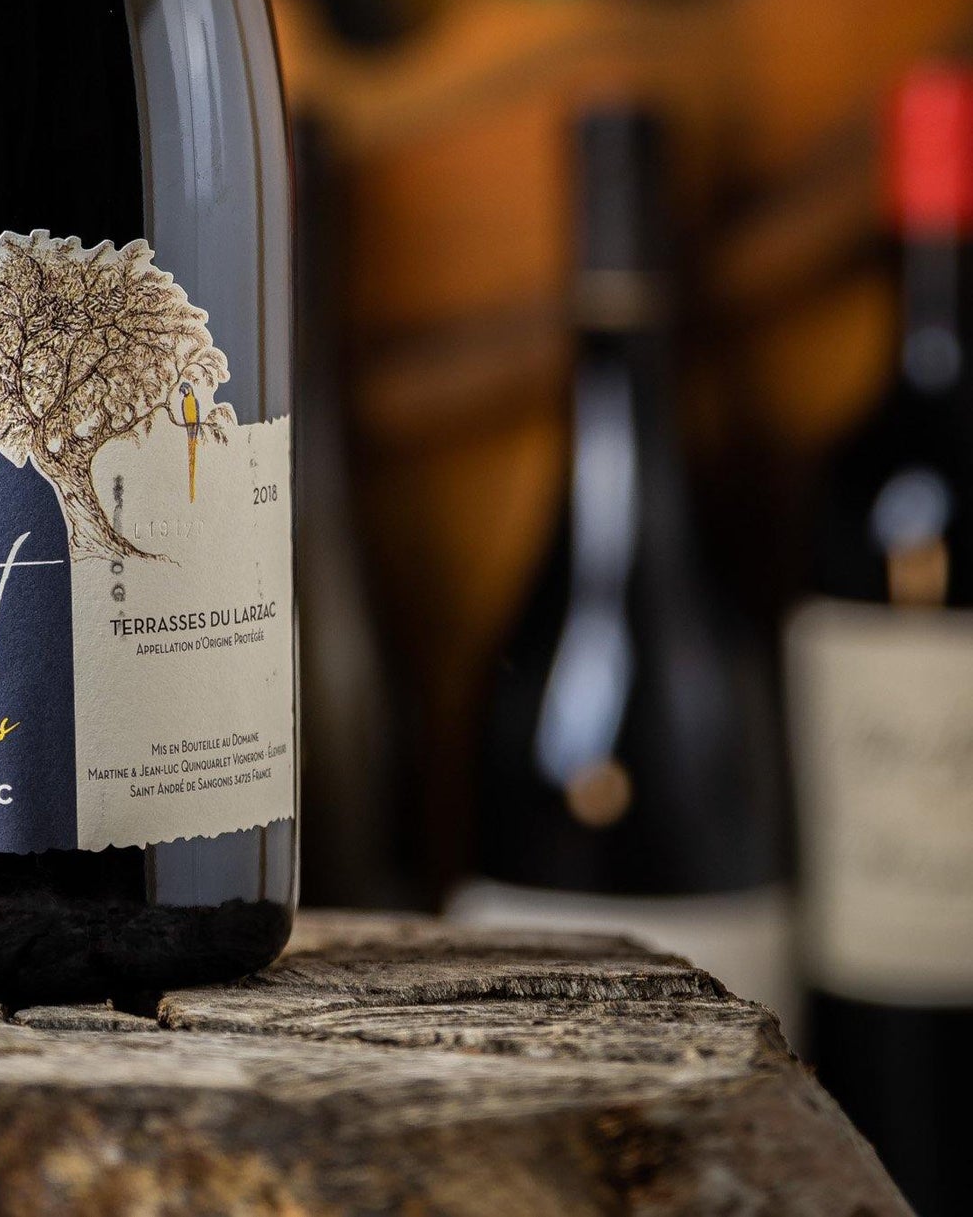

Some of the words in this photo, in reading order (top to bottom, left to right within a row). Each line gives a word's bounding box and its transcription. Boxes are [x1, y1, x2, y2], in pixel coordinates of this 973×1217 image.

[253, 484, 279, 506] 2018
[110, 613, 207, 637] TERRASSES
[210, 609, 231, 629] DU
[233, 601, 277, 625] LARZAC
